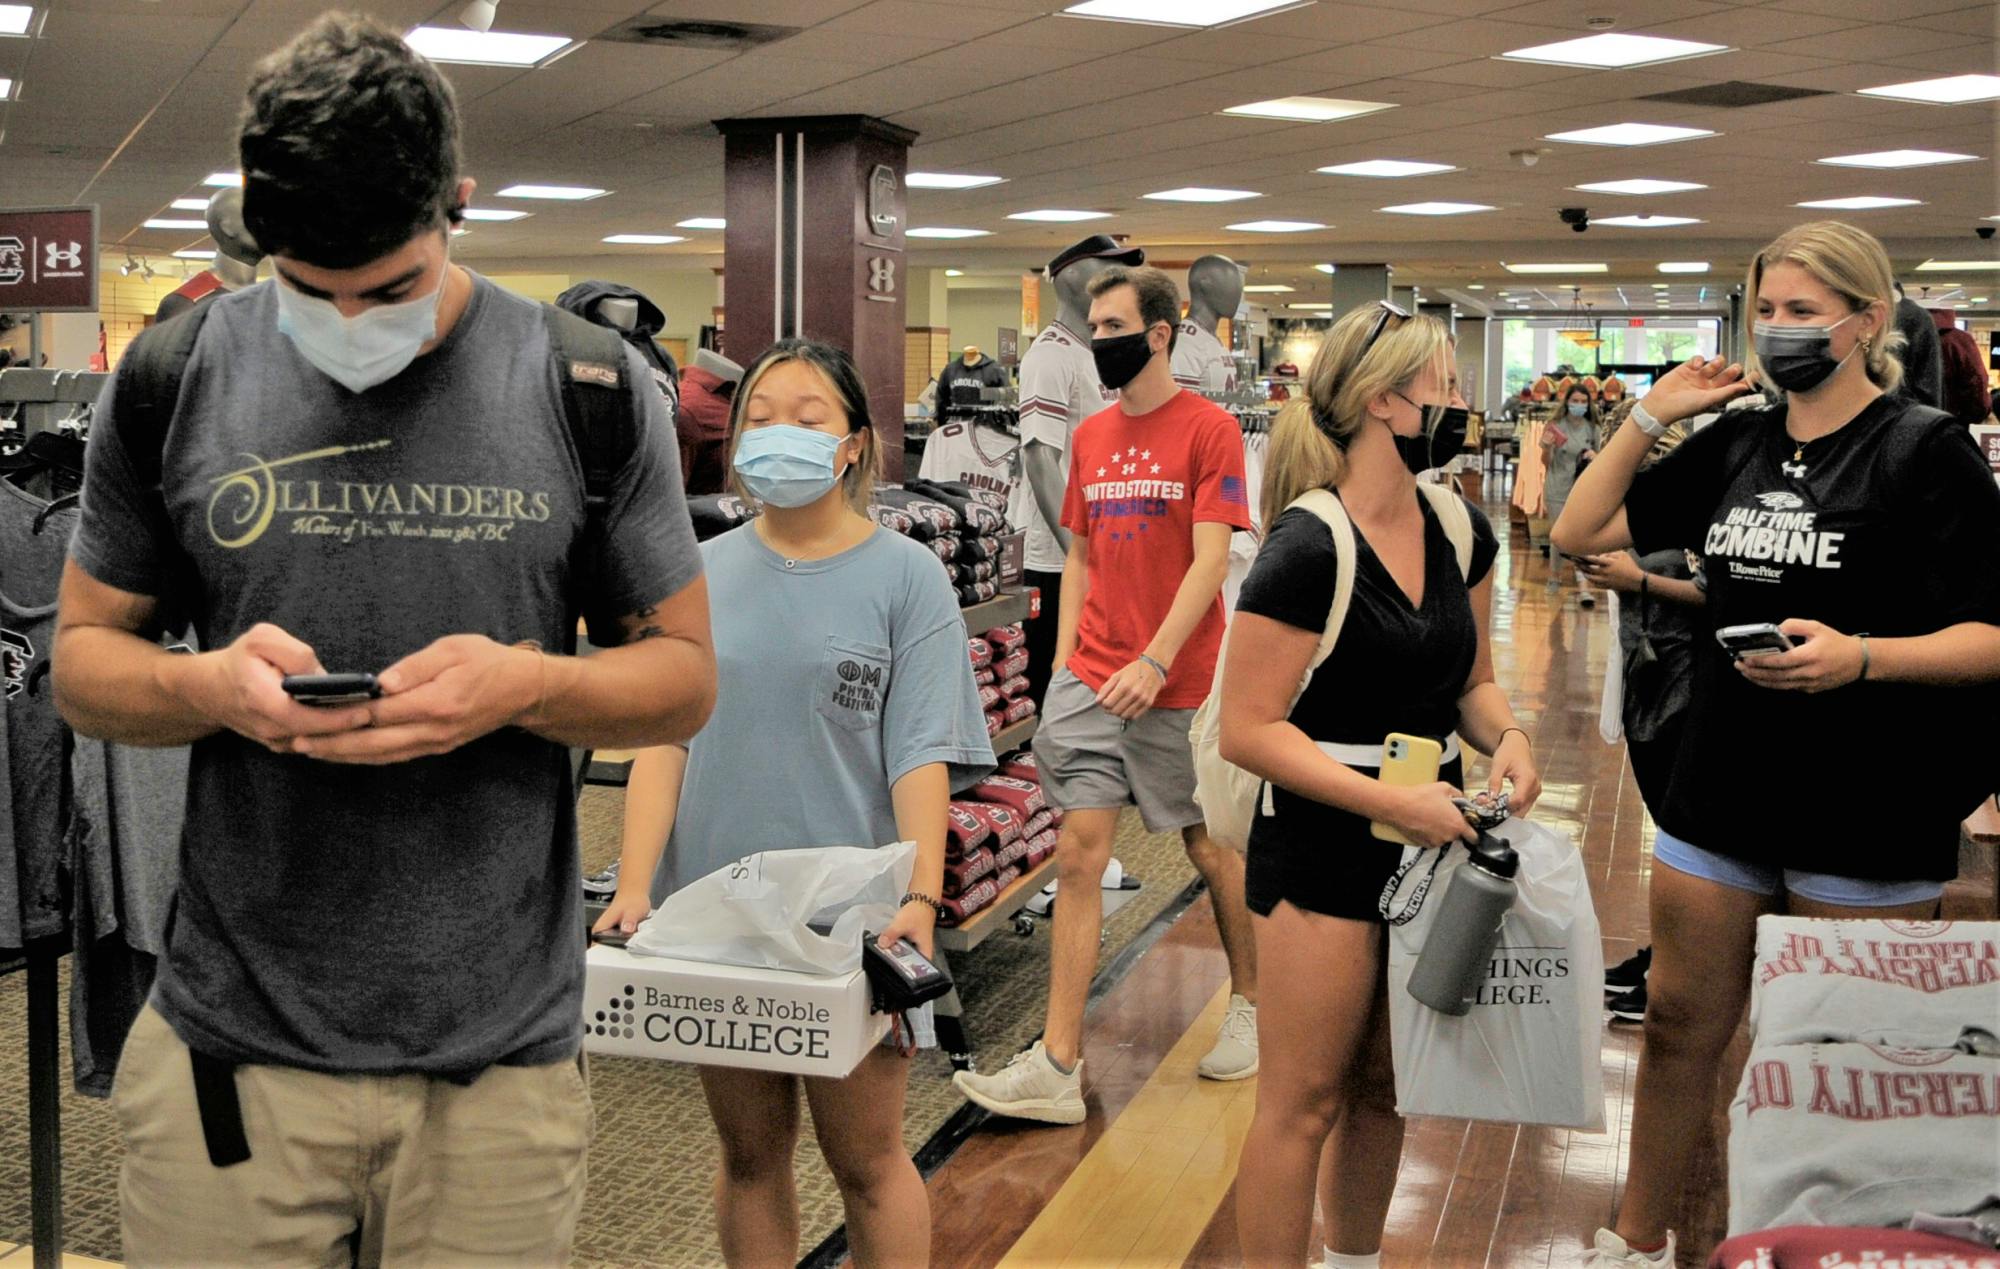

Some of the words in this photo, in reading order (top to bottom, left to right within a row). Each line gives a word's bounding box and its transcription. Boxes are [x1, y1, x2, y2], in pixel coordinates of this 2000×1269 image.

[207, 452, 550, 548] OLLIVANDERS
[1126, 479, 1184, 500] STATES
[1704, 523, 1845, 568] COMBINE
[1486, 957, 1568, 979] HINGS
[644, 986, 724, 1014] Barnes
[732, 996, 749, 1015] &
[756, 998, 830, 1023] Noble
[1475, 984, 1550, 1006] LEGE.
[643, 1013, 830, 1059] COLLEGE
[1808, 1063, 2000, 1122] ERSITY
